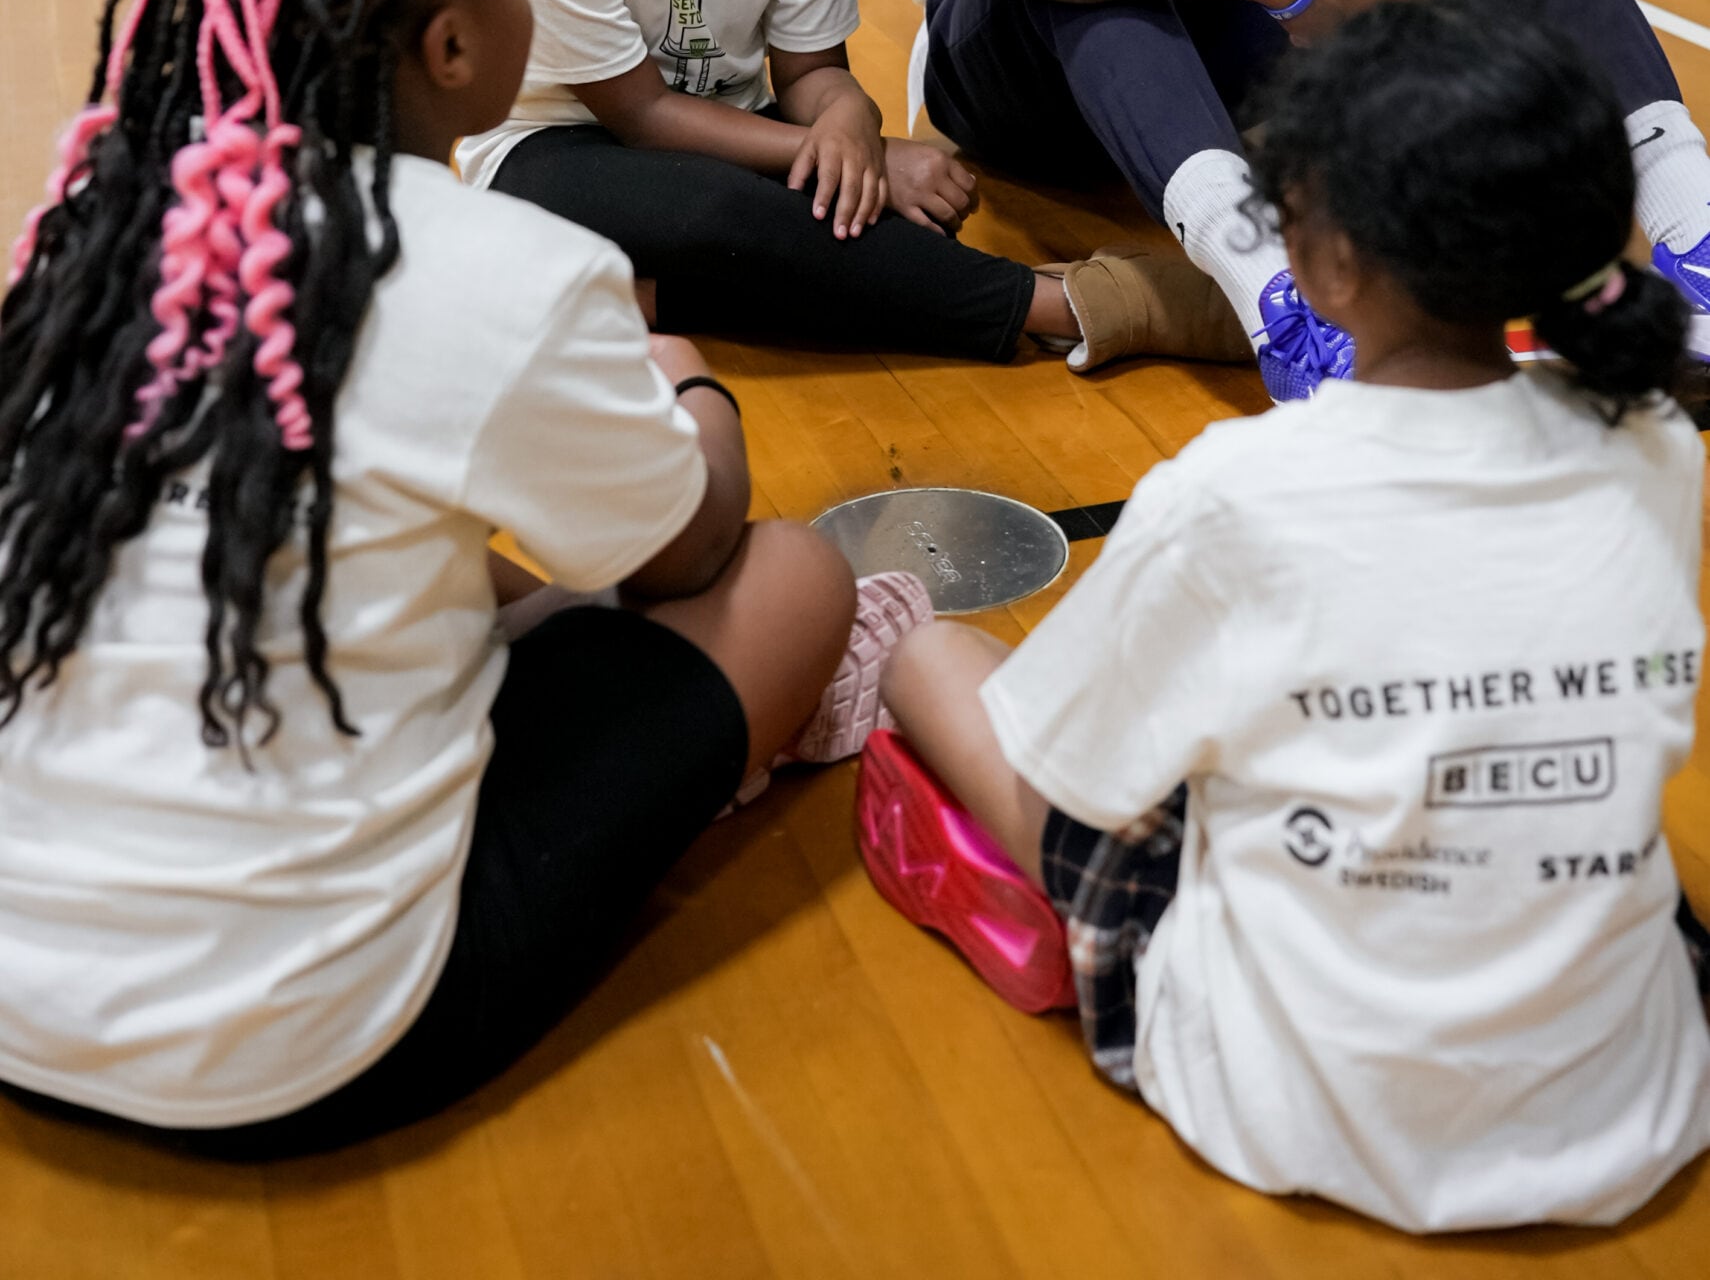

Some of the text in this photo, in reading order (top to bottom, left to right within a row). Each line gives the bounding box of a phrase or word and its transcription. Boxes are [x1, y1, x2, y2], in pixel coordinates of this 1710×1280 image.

[1289, 669, 1535, 720] TOGETHER
[1554, 660, 1617, 698] WE
[1443, 756, 1600, 793] BECU
